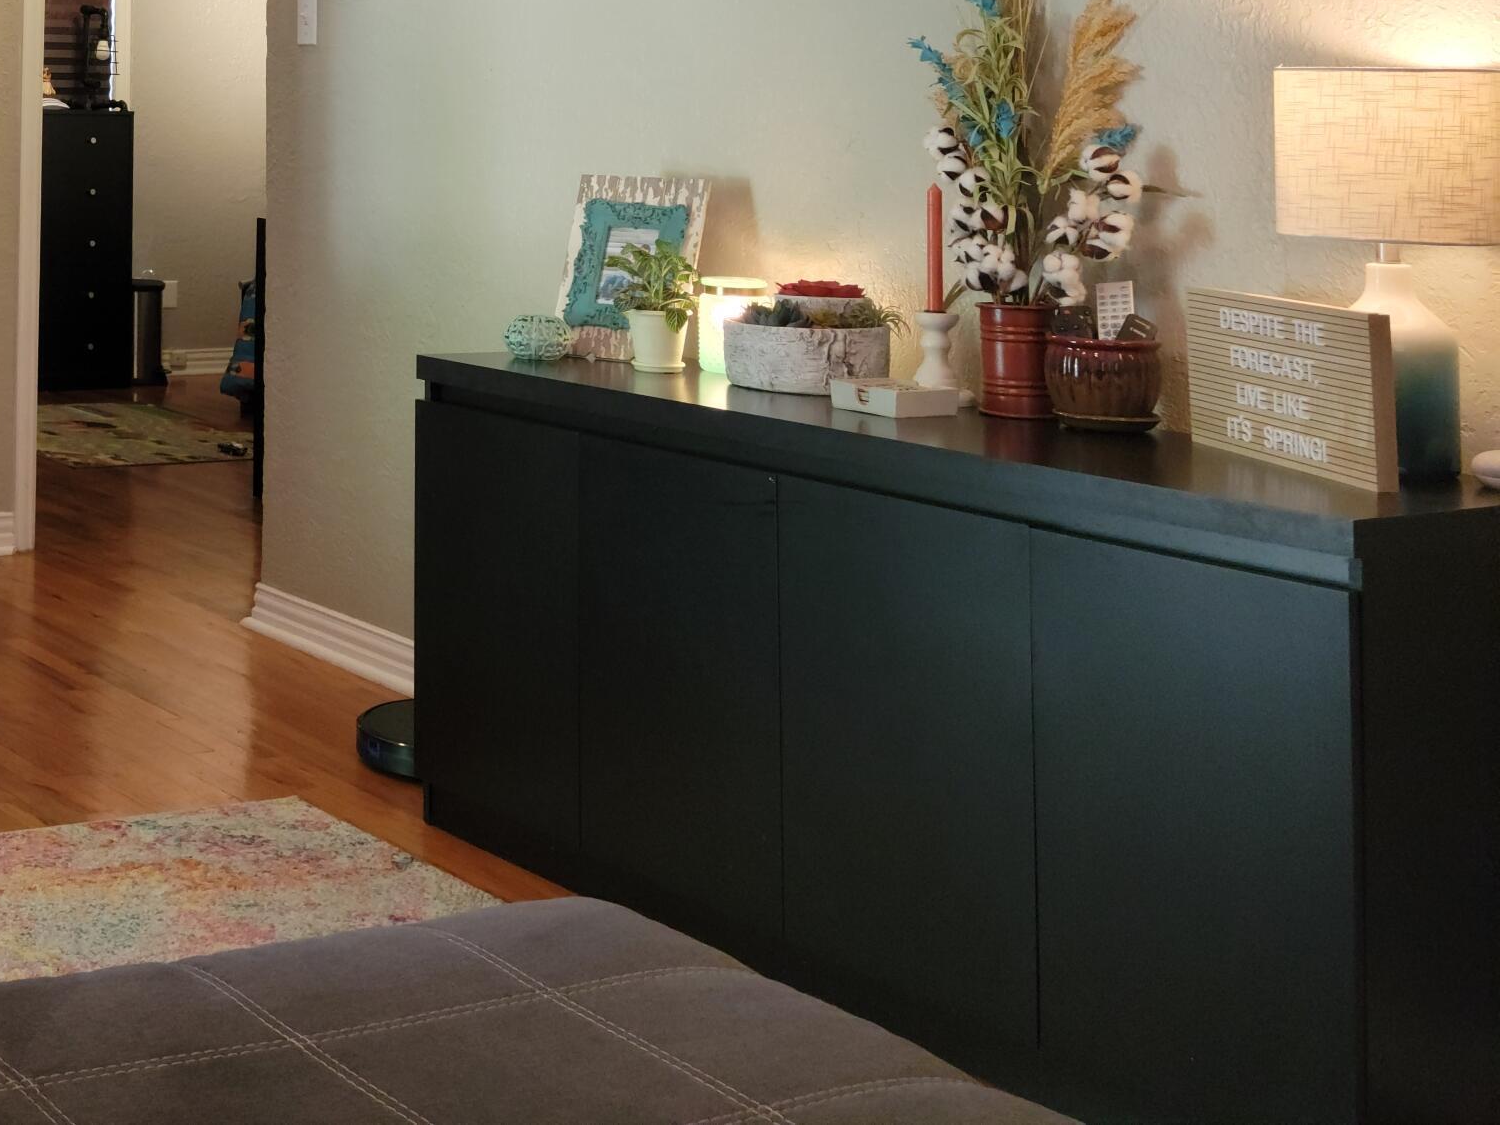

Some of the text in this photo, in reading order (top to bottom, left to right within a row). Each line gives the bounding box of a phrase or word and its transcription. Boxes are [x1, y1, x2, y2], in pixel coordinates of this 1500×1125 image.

[1220, 308, 1326, 347] DESPITE THE
[1230, 347, 1319, 385] FORECAST,
[1236, 382, 1311, 421] LIVE LIKE
[1226, 415, 1328, 464] IT'S SPRING!
